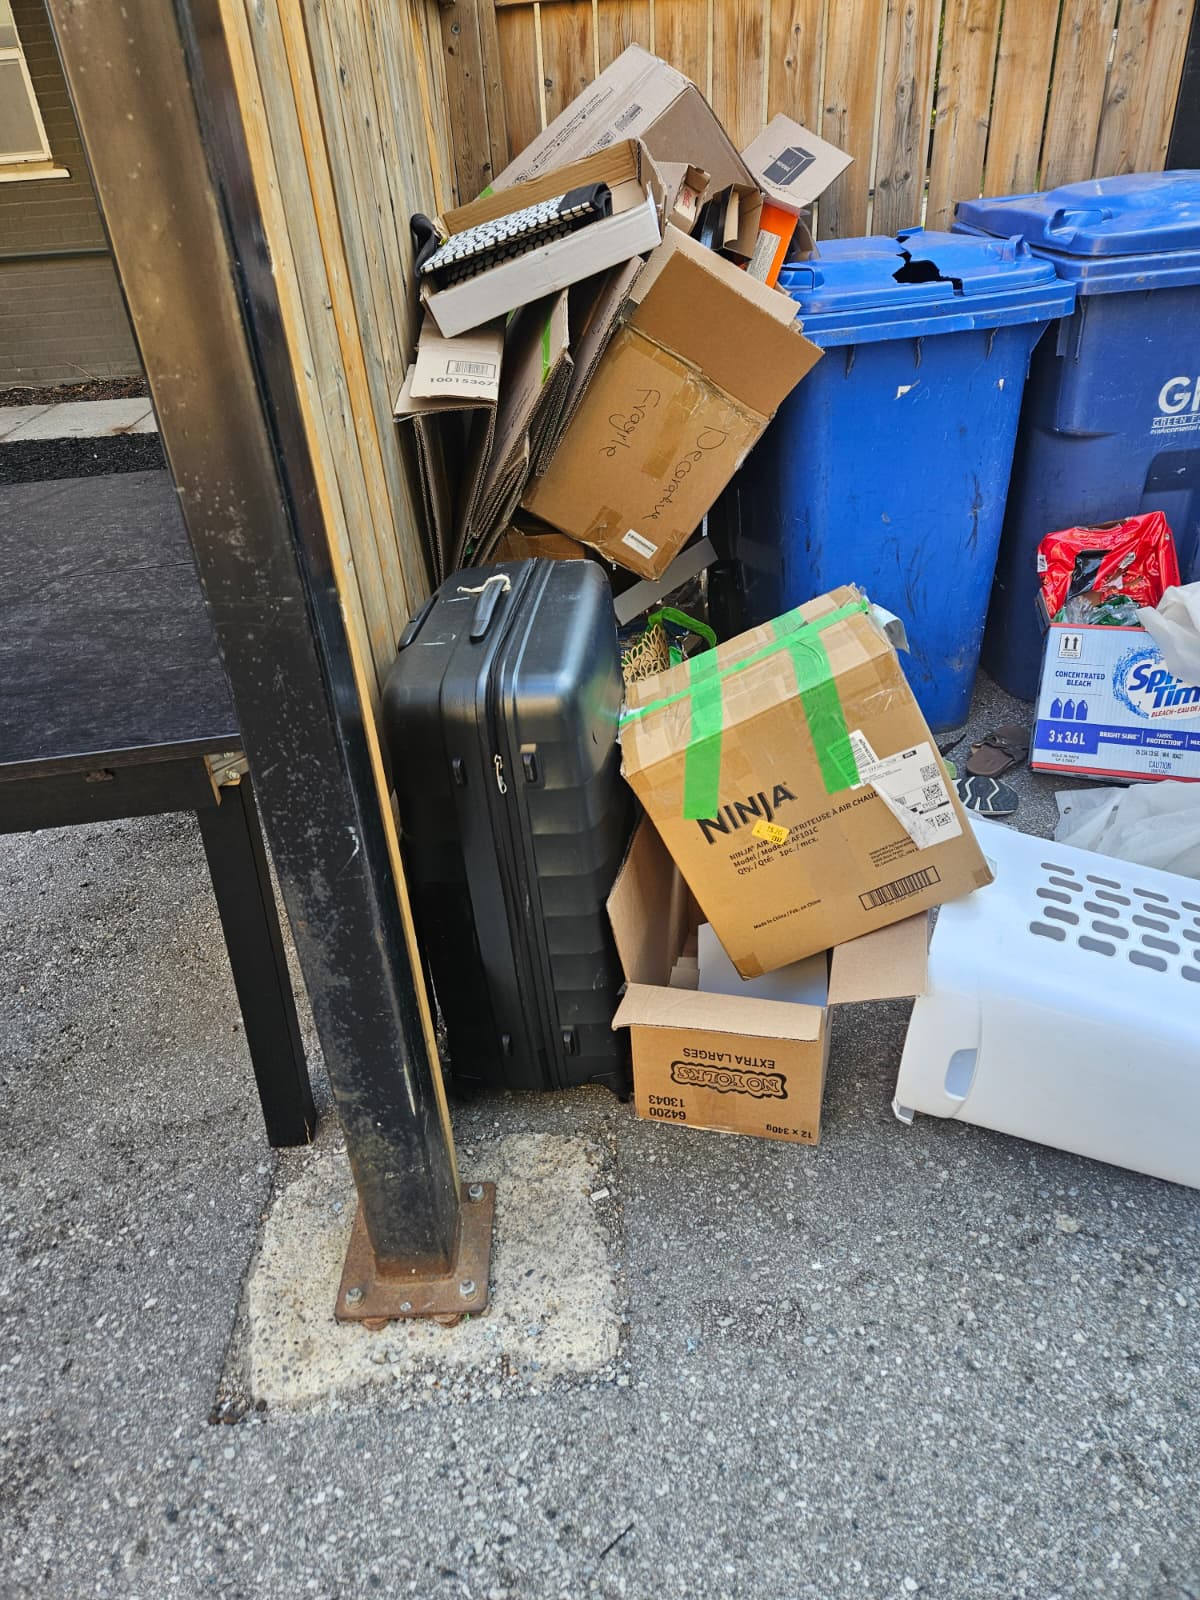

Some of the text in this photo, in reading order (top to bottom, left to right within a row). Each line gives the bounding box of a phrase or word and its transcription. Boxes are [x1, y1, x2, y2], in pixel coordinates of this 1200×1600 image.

[1055, 670, 1106, 681] CONCENTRATED
[1049, 730, 1086, 745] 3 x 3.6 L
[696, 784, 798, 846] NINJA
[756, 837, 770, 850] AIR
[838, 803, 852, 815] AIR
[733, 854, 756, 868] Model
[791, 826, 819, 843] AF101C
[683, 1048, 776, 1069] EXTRA LARGES
[677, 1066, 780, 1094] NO YOLKS
[649, 1094, 686, 1109] 13043
[649, 1106, 687, 1121] 64200
[765, 1123, 790, 1135] 340g
[801, 1129, 813, 1139] 12
